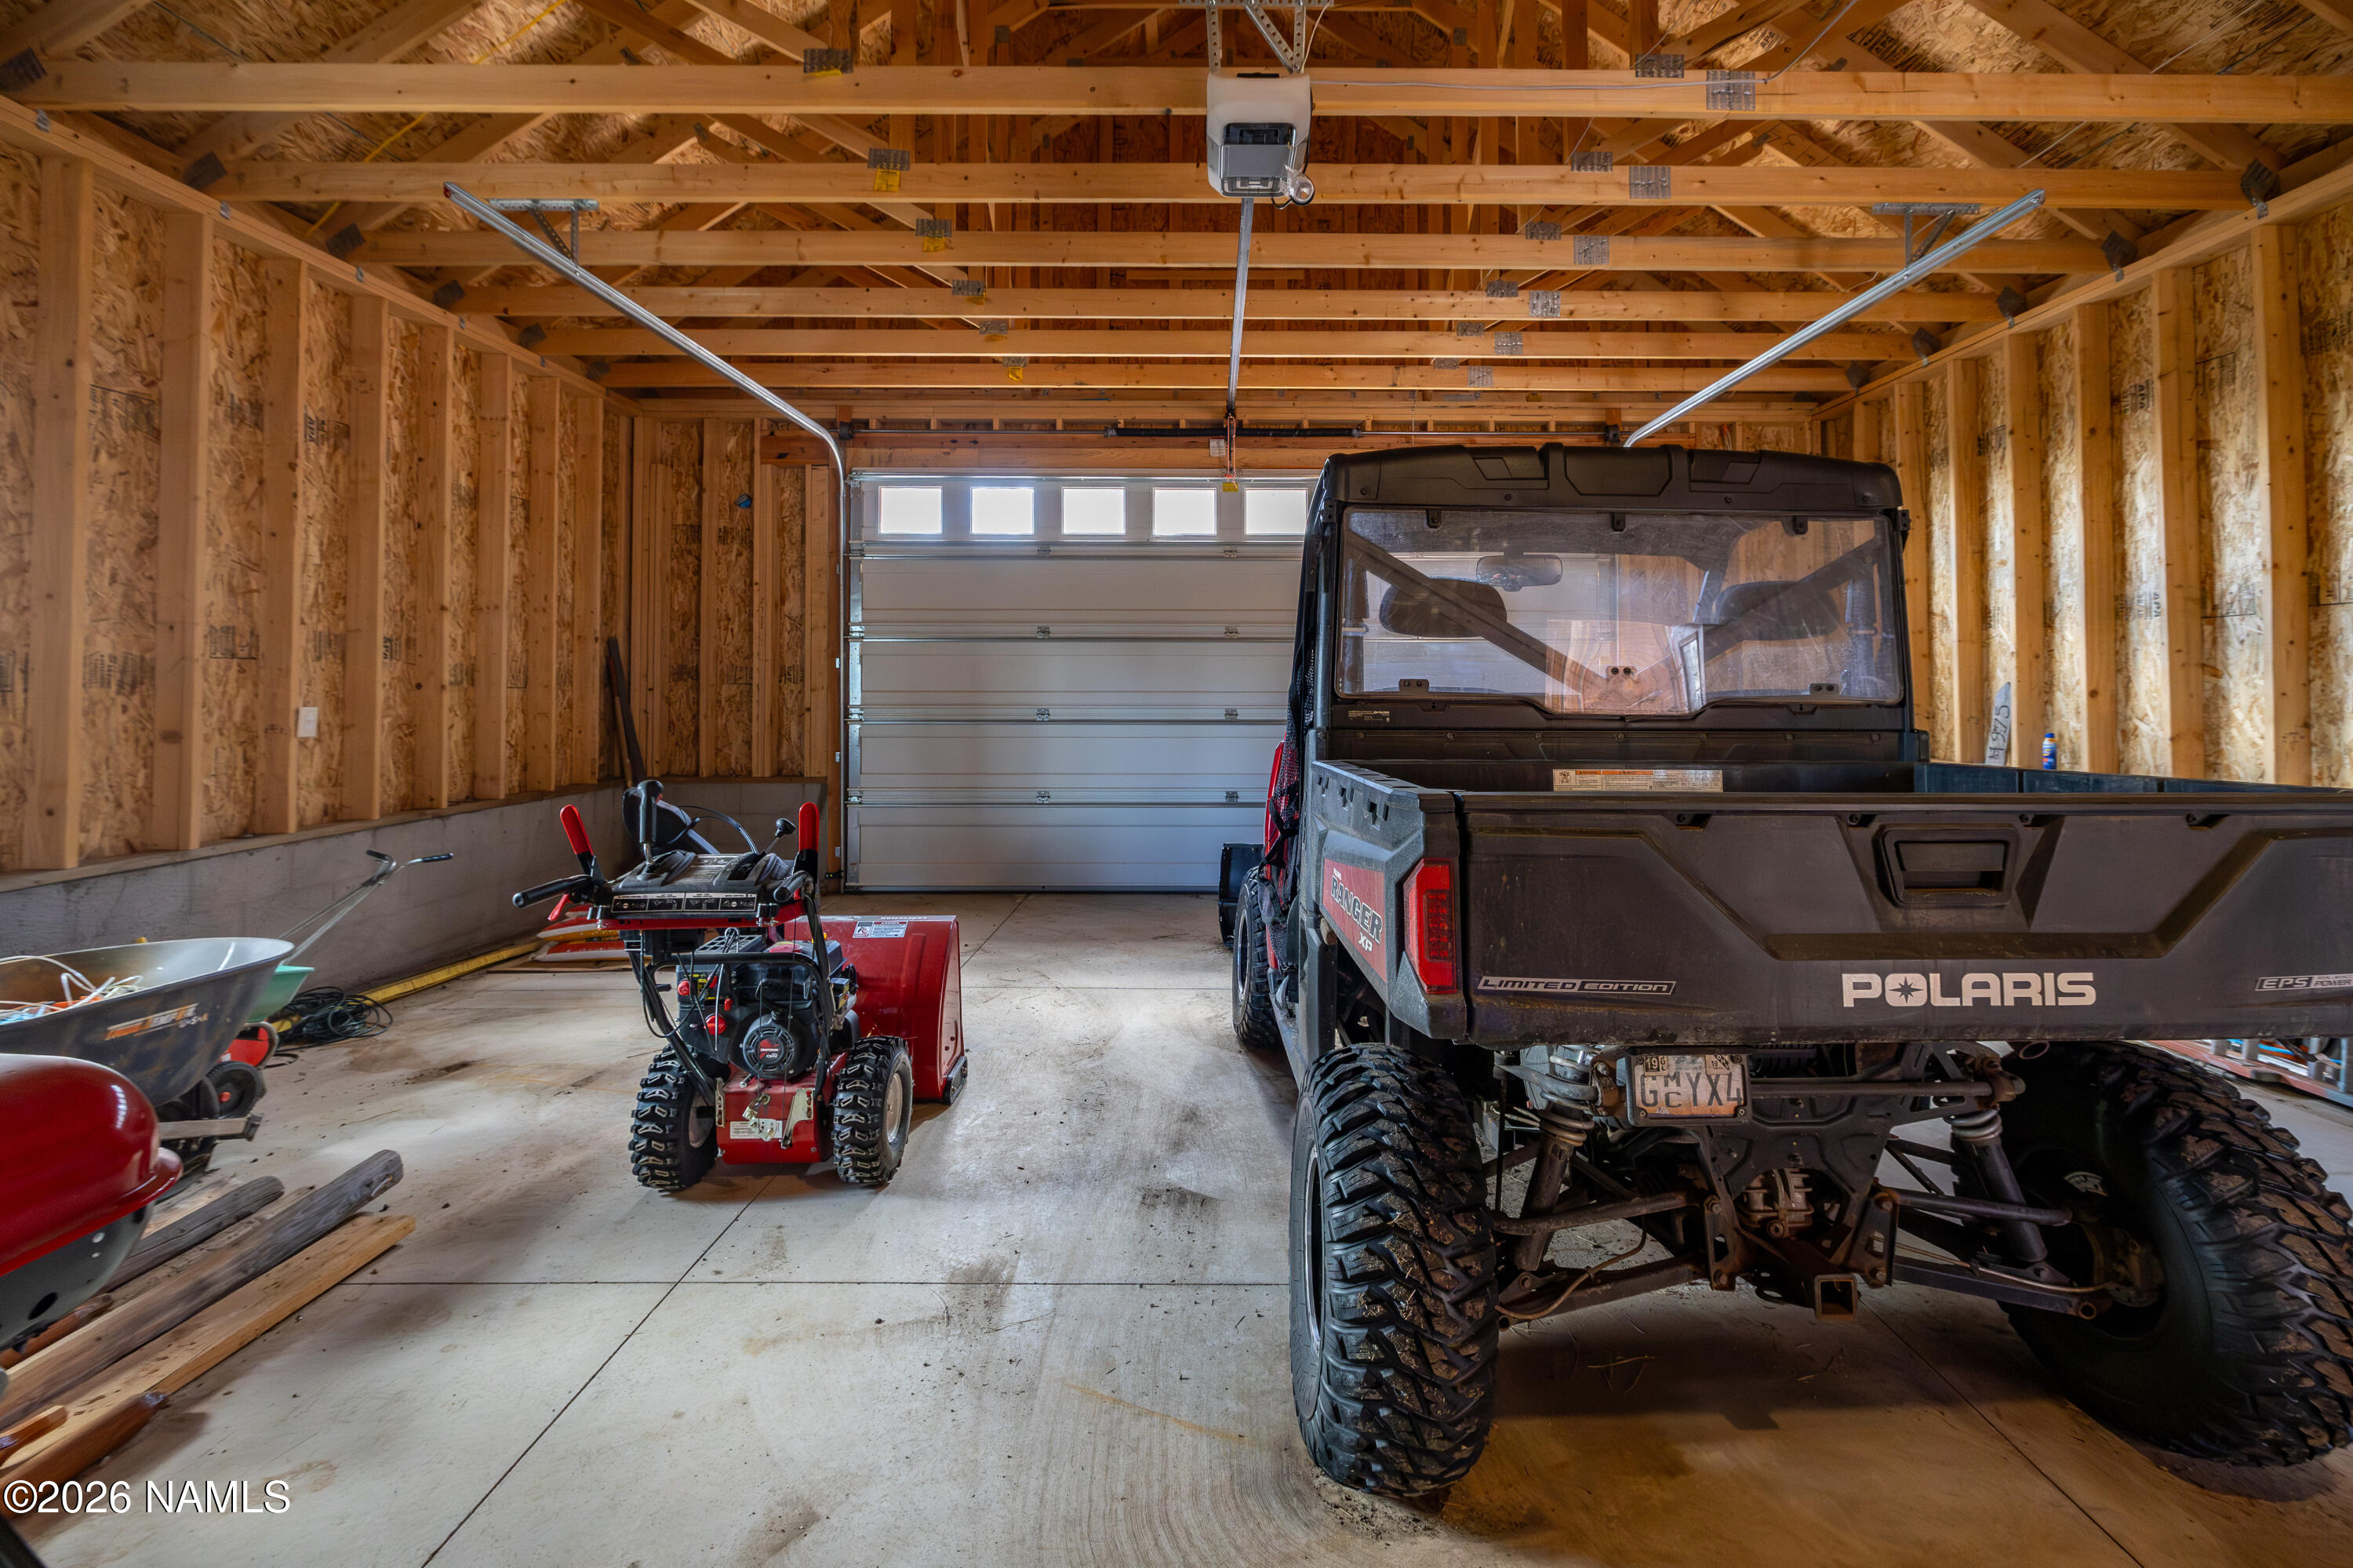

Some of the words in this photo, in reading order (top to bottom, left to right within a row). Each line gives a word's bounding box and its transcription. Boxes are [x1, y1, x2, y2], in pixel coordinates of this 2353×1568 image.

[1331, 875, 1383, 946] RANGER
[1358, 932, 1373, 951] XP
[1483, 979, 1577, 990] LIMITED
[1584, 982, 1646, 992] EDITION
[1842, 972, 2097, 1007] POLARIS
[2262, 977, 2310, 989] EPS
[1646, 1059, 1659, 1070] 19
